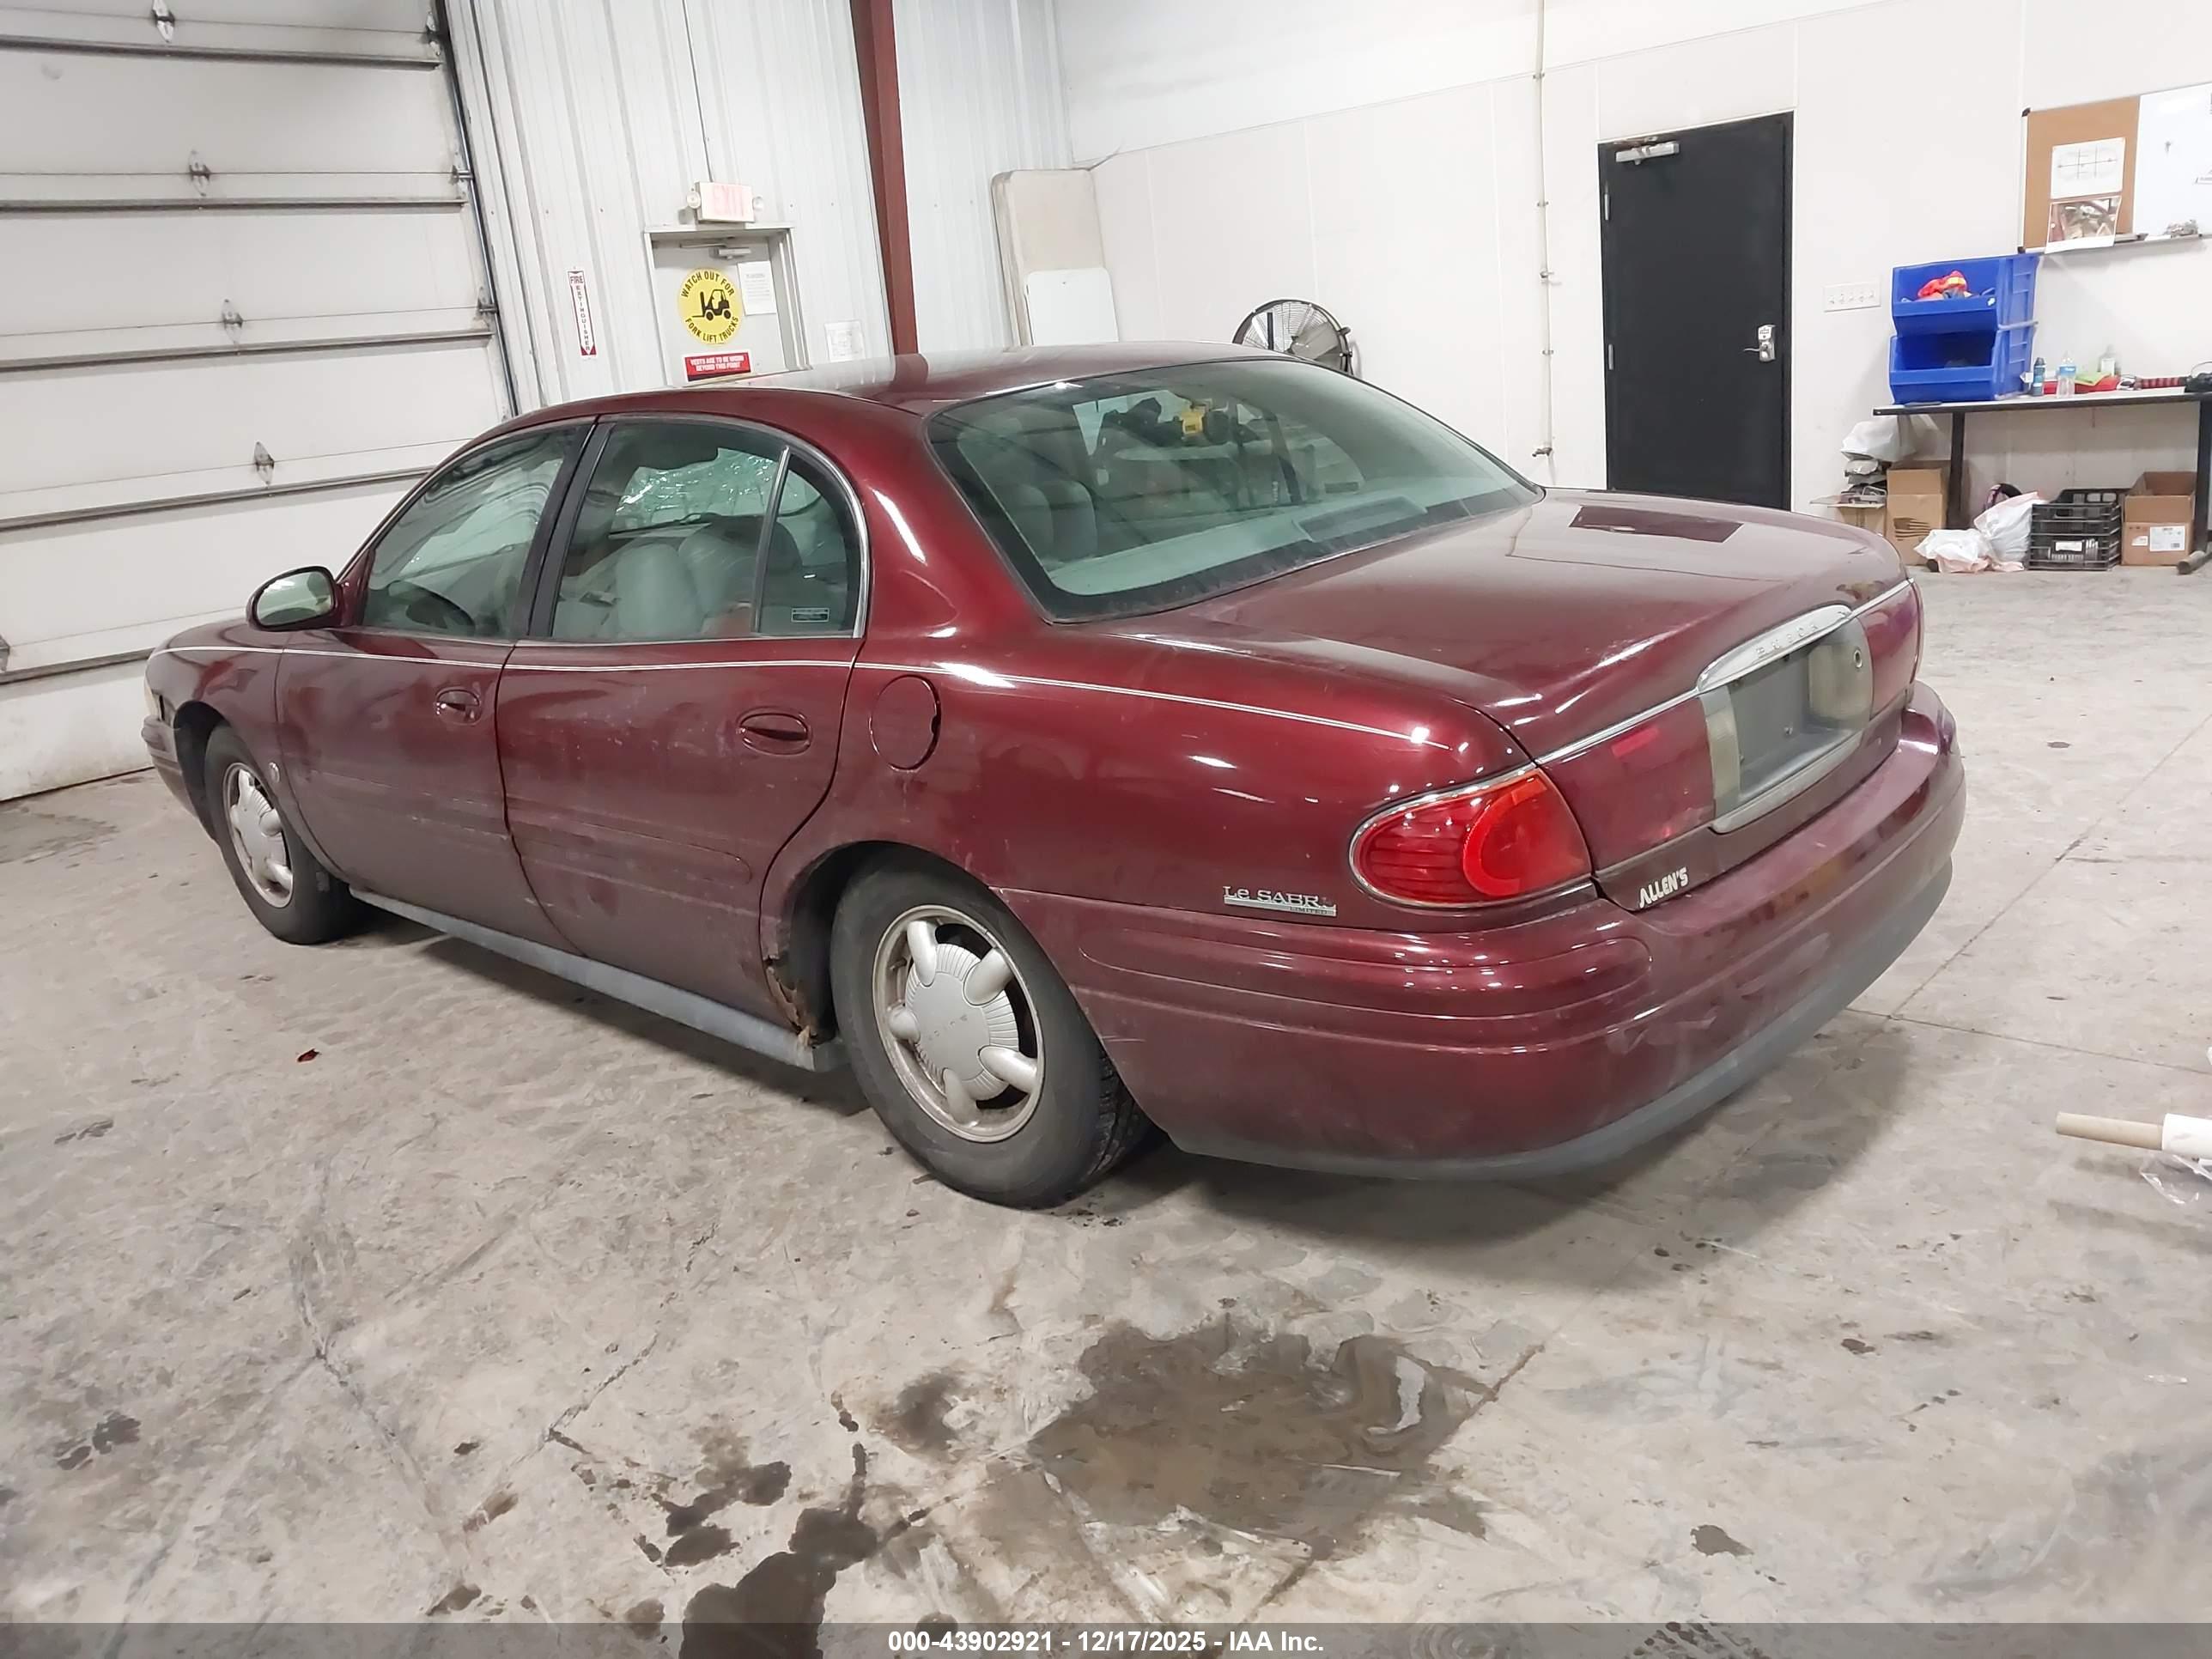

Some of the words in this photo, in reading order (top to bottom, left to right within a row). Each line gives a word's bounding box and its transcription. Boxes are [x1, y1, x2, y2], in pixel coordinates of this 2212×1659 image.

[570, 275, 584, 284] FIRE
[680, 271, 702, 298] WATCH
[703, 270, 720, 282] OUT
[720, 279, 735, 296] FOR
[576, 285, 591, 351] EXTINGUISHER
[684, 317, 701, 337] FORK
[702, 332, 718, 343] LIFT
[719, 316, 739, 341] TRUCKS
[1638, 866, 1689, 908] ALLEN'S
[1290, 906, 1328, 915] LIMITED
